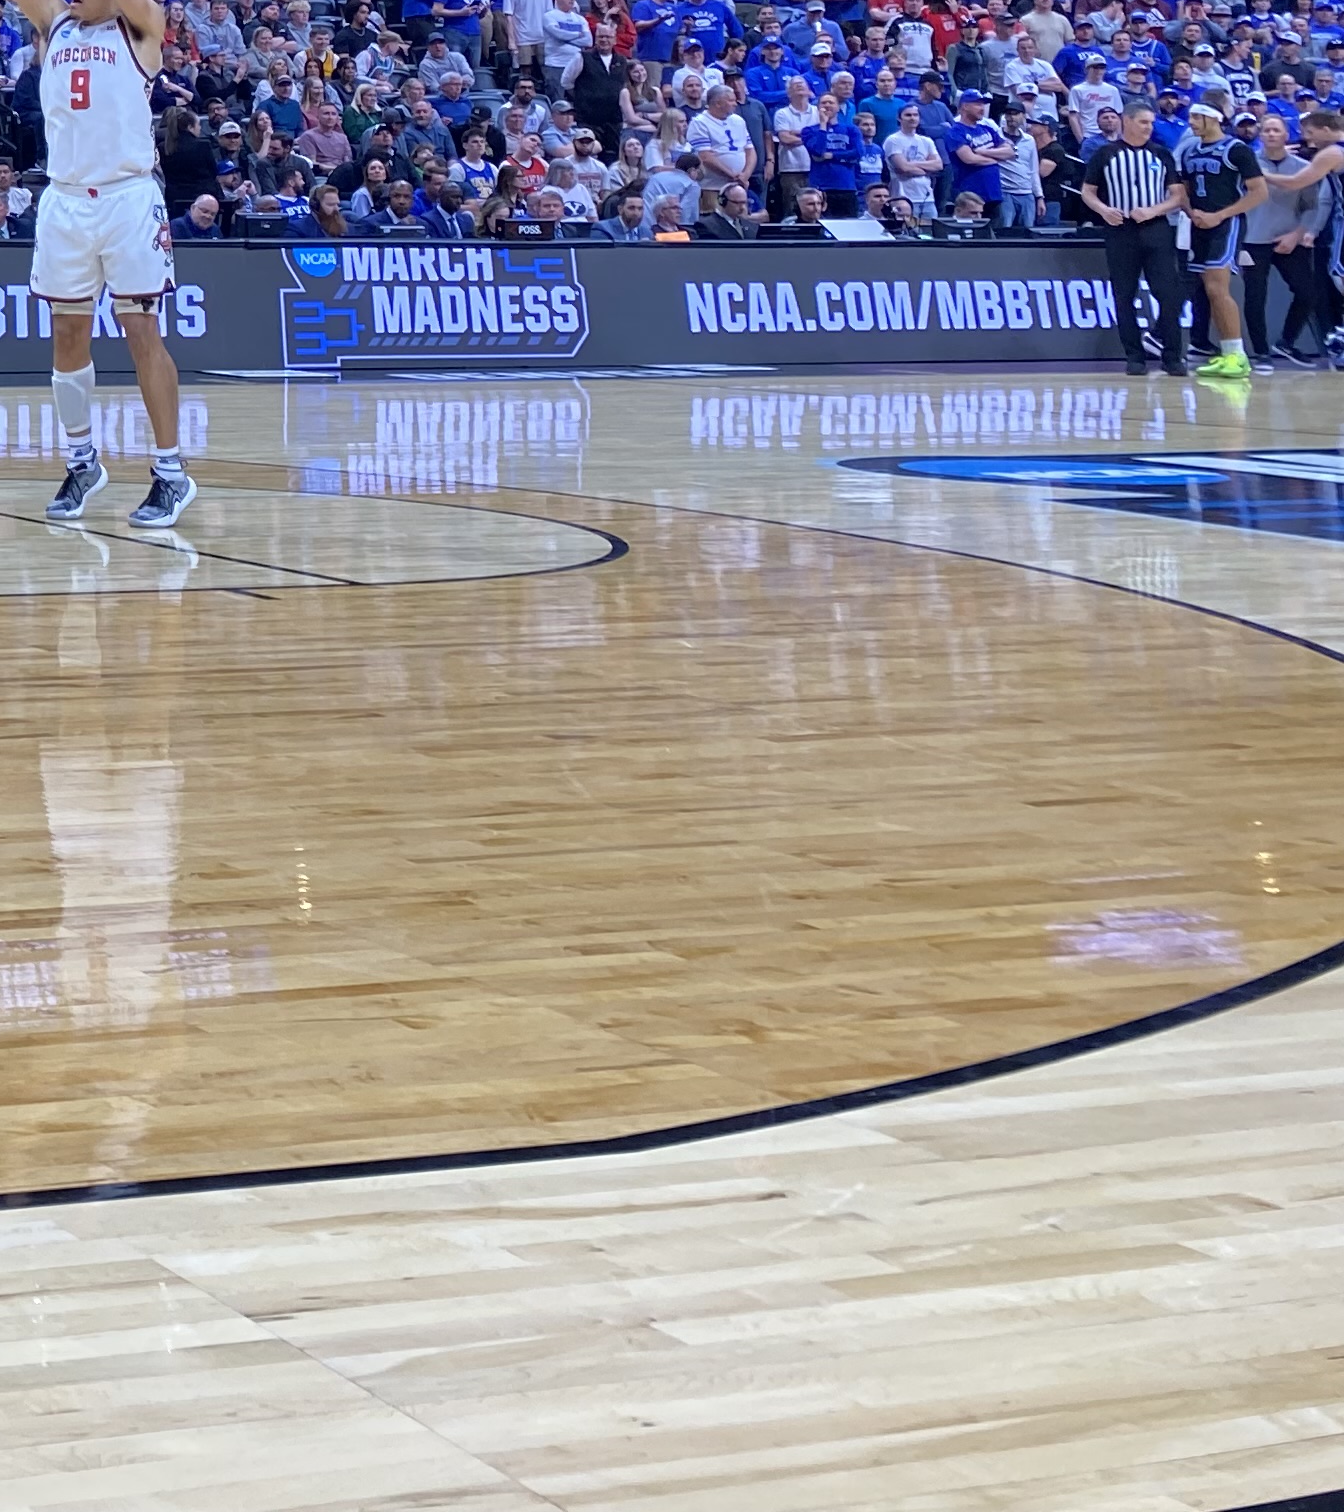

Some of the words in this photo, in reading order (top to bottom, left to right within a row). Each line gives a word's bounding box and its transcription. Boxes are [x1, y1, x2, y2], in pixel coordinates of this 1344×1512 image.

[50, 45, 117, 69] WISCONSIN
[70, 69, 91, 110] 9
[1234, 82, 1250, 96] 32
[725, 129, 736, 154] 1
[1196, 174, 1208, 197] 1
[285, 205, 311, 217] BYU
[518, 224, 543, 235] POSS.
[299, 252, 337, 265] NCAA
[342, 247, 495, 282] MARCH
[371, 285, 580, 334] MADNESS
[685, 279, 1193, 333] NCAA.COM/MBBTICK
